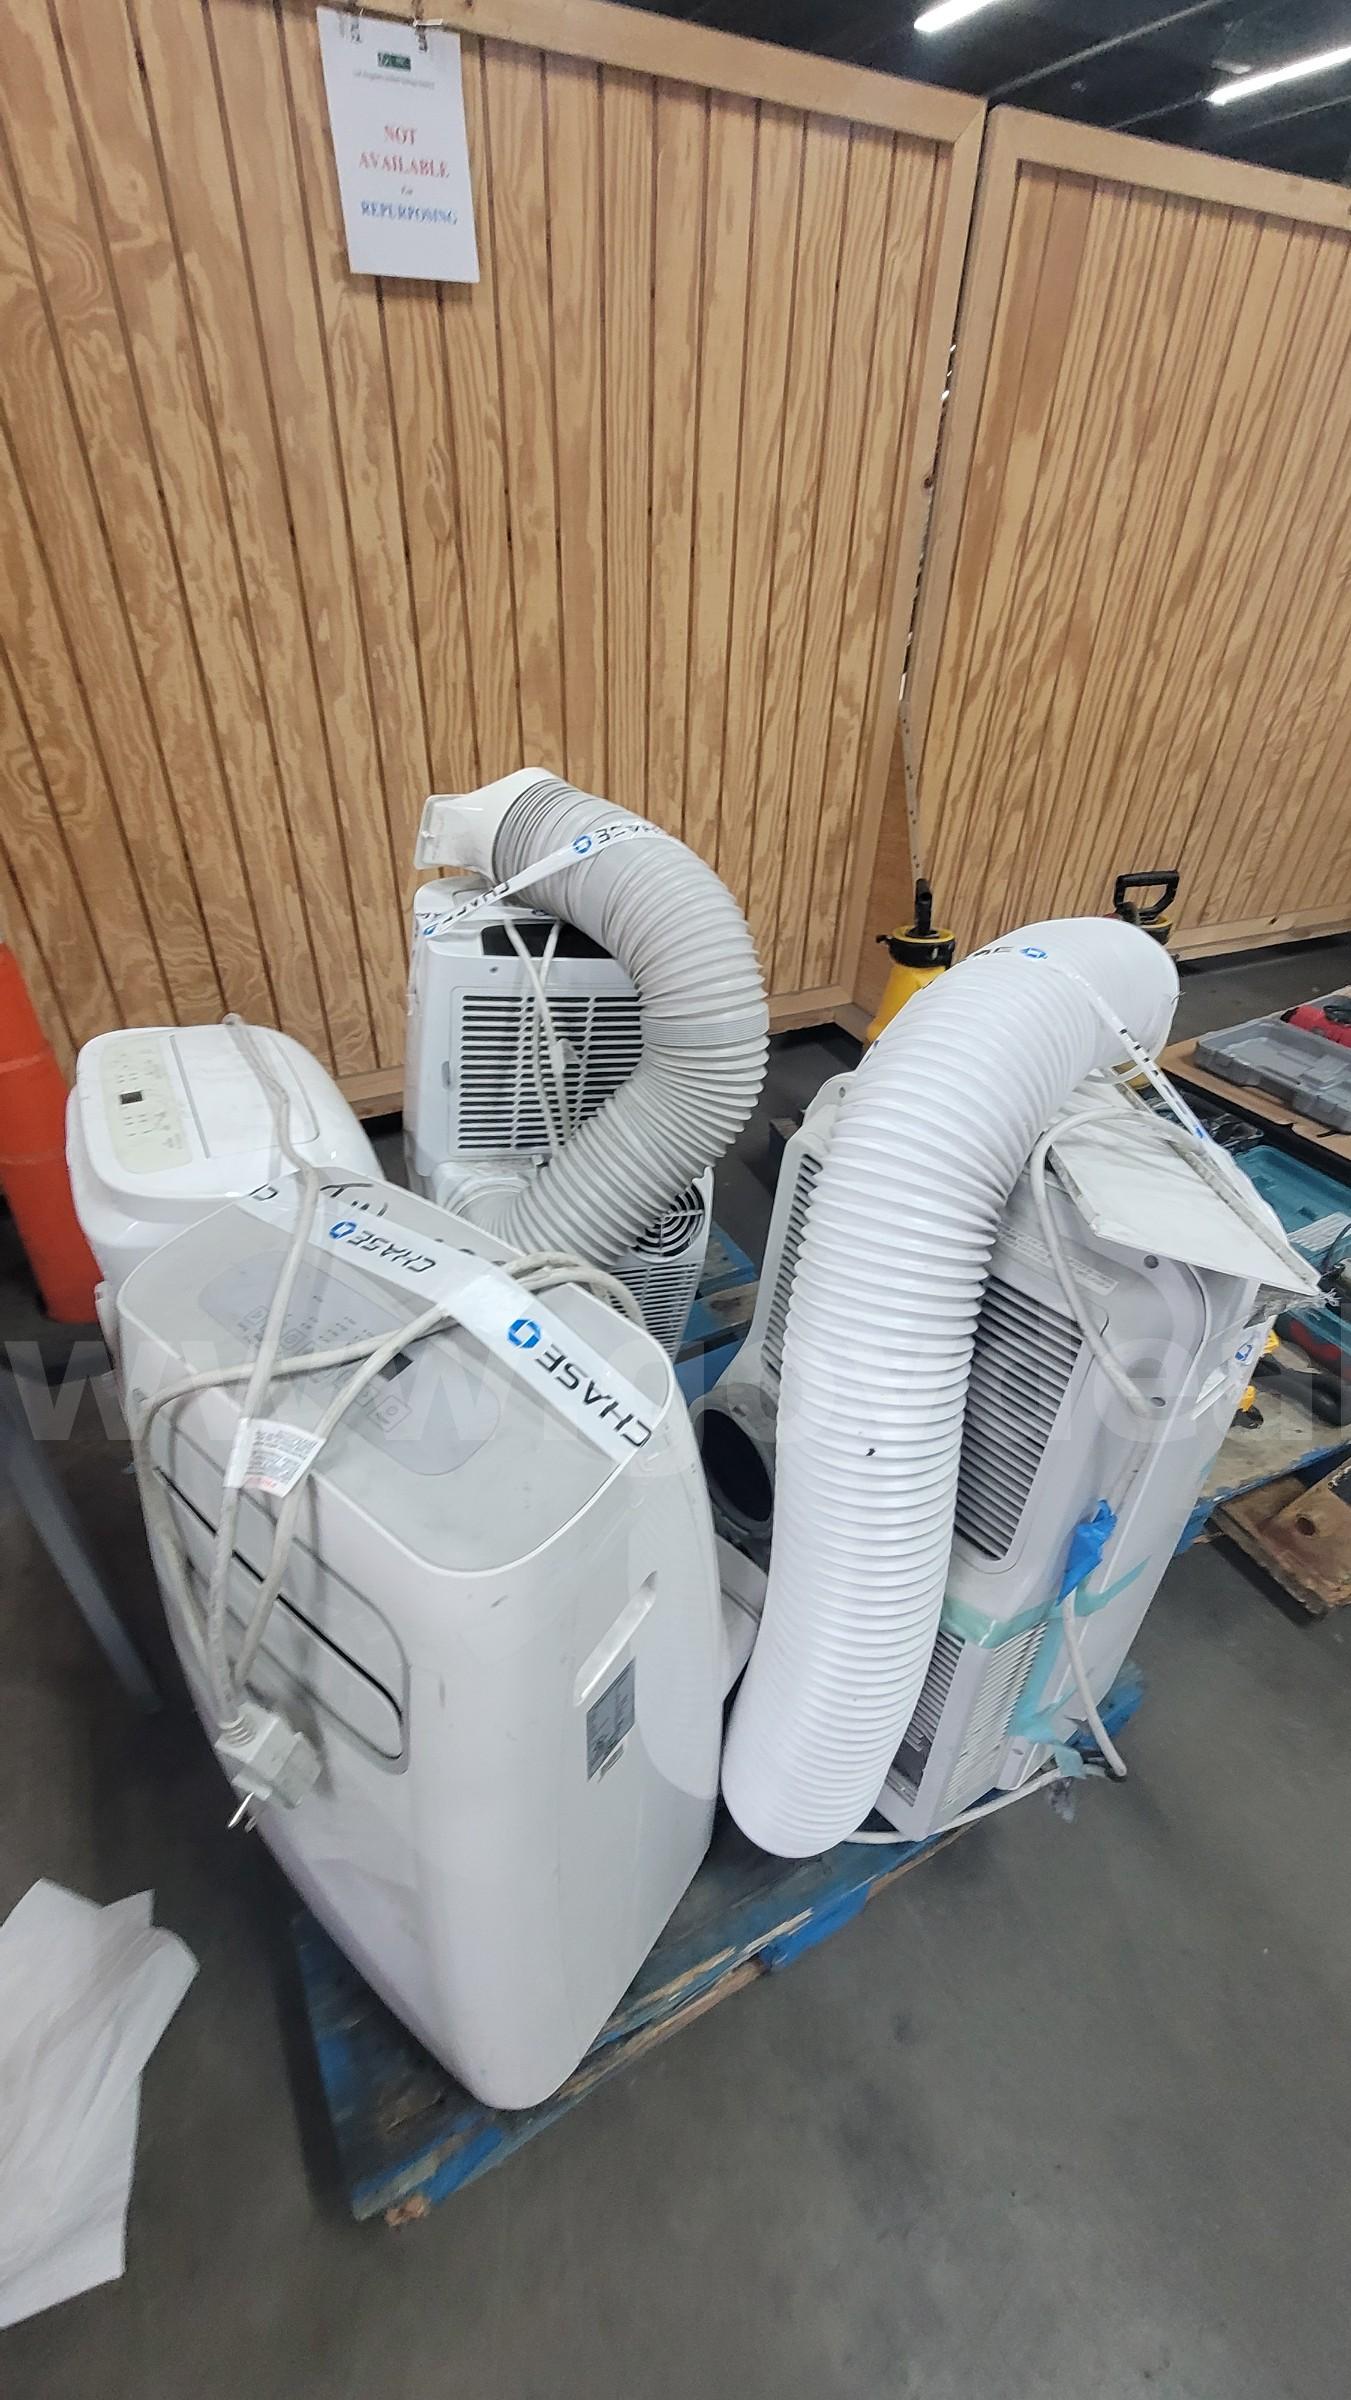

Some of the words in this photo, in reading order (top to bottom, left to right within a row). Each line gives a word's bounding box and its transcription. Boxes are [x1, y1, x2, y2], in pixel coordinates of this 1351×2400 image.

[383, 125, 417, 145] NOT
[359, 151, 450, 178] AVAILABLE
[346, 1230, 436, 1273] CHASE
[535, 1343, 652, 1447] CHASE
